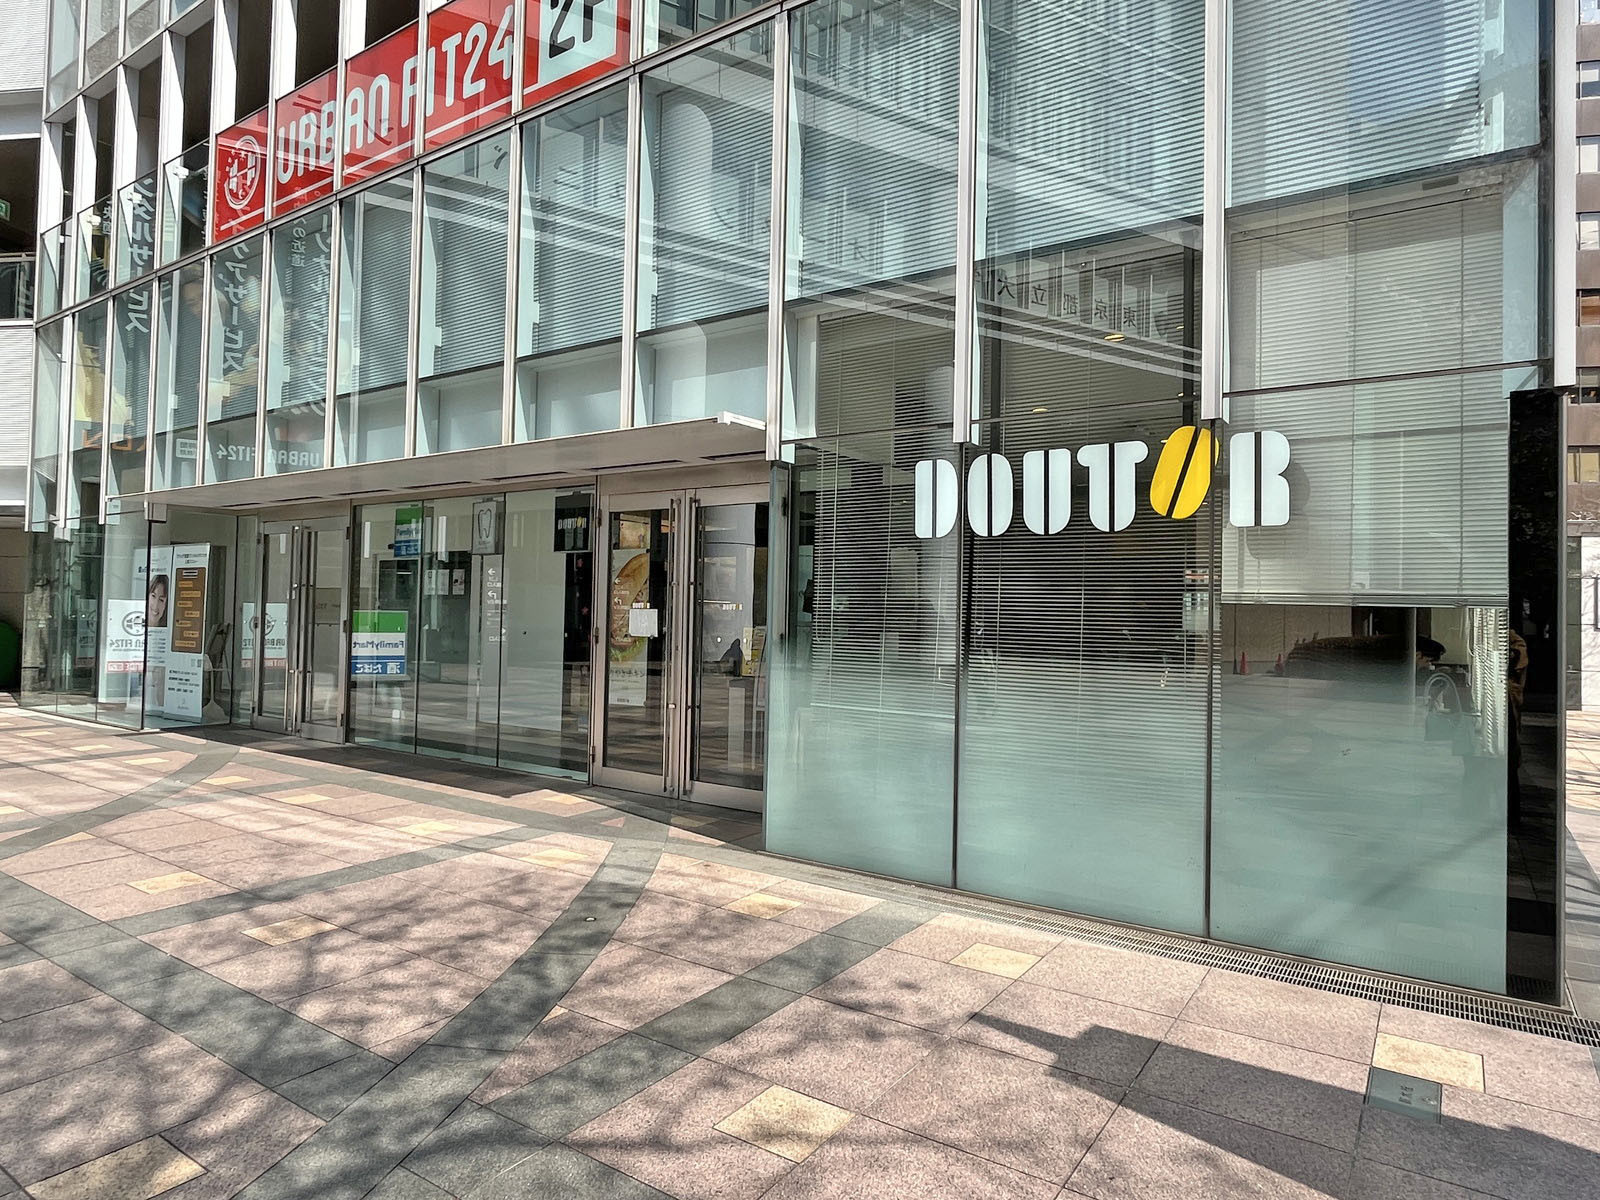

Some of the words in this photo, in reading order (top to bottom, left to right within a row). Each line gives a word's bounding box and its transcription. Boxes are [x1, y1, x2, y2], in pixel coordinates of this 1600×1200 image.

[277, 74, 390, 184] URBAN
[401, 4, 514, 128] FIT24
[914, 425, 1291, 539] DOUTOR
